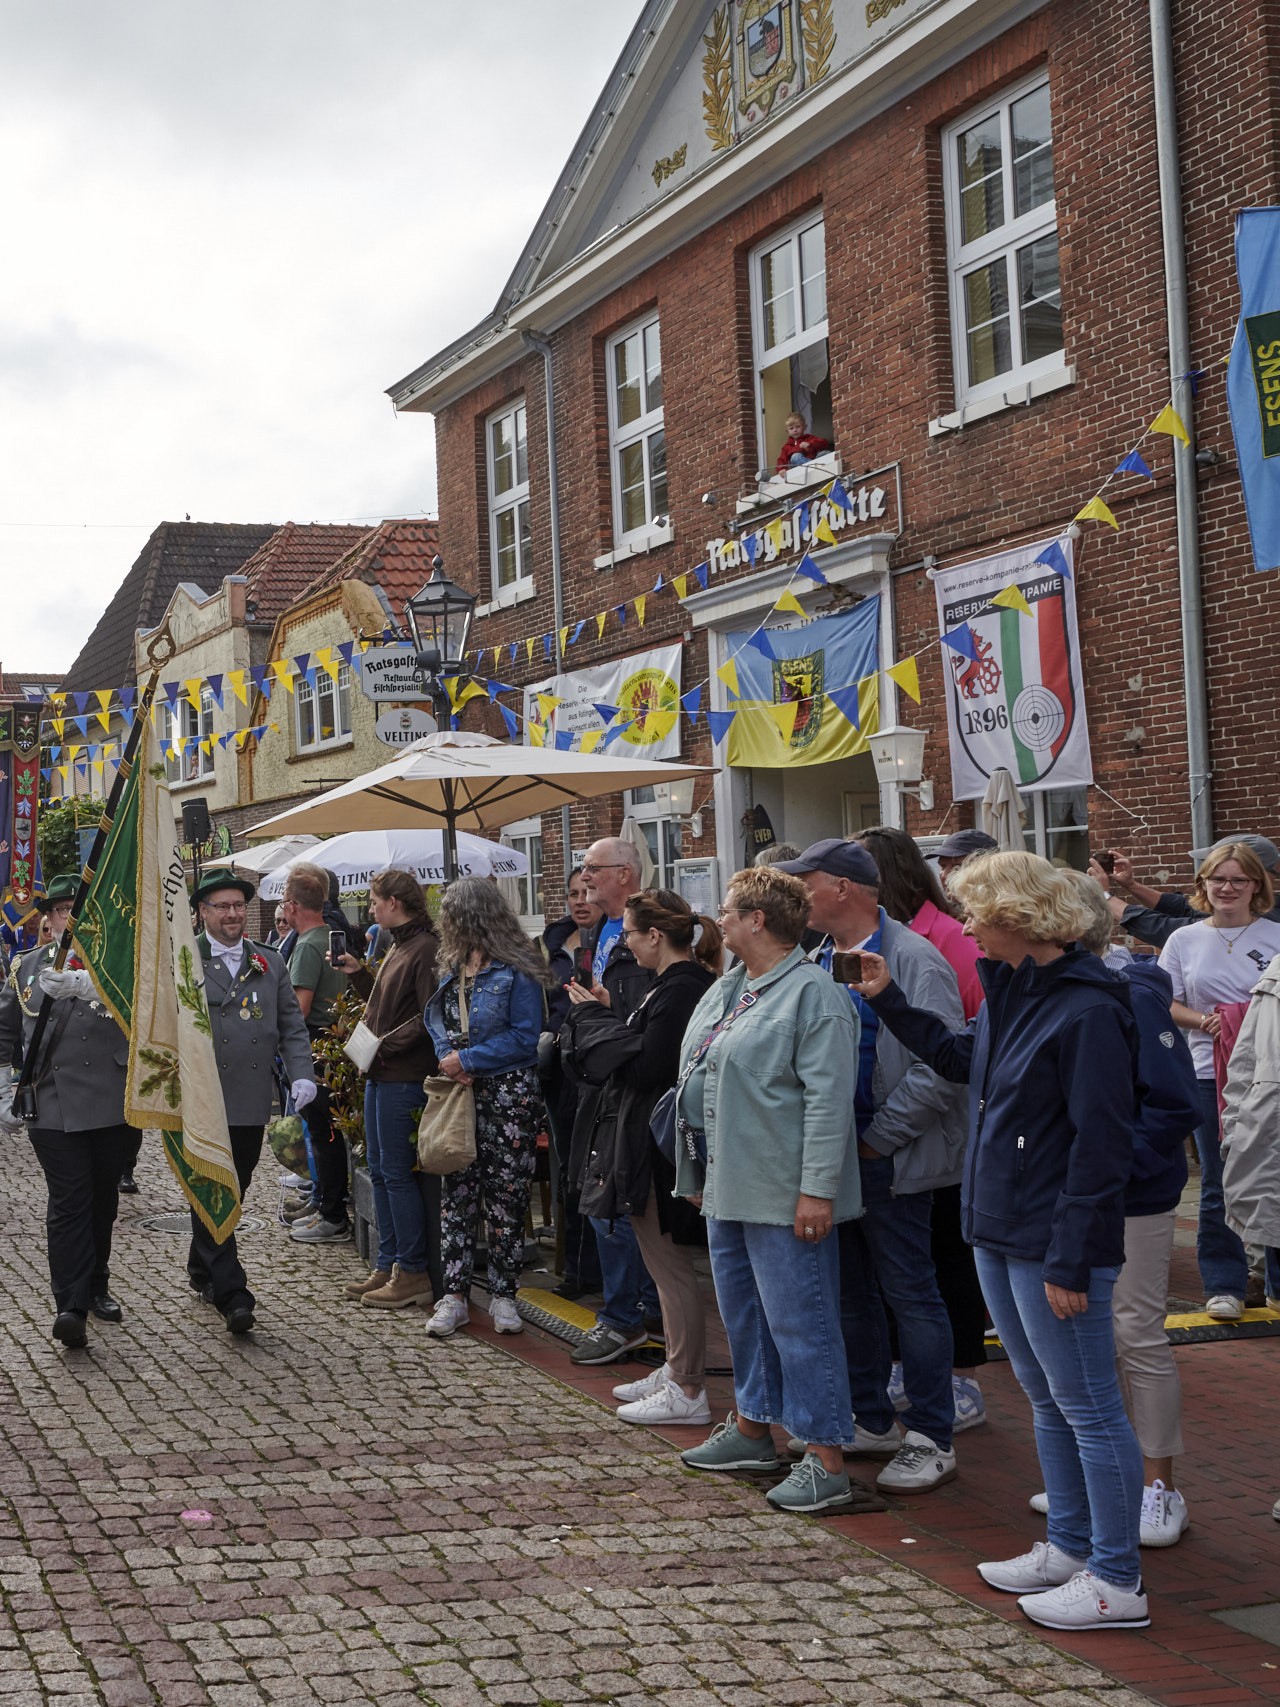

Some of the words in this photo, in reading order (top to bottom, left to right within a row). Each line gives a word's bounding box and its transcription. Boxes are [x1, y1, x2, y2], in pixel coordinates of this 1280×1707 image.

[945, 598, 993, 620] RESERVE
[1021, 578, 1062, 600] MPANIE
[964, 704, 1009, 735] 1896
[384, 731, 428, 742] VELTINS
